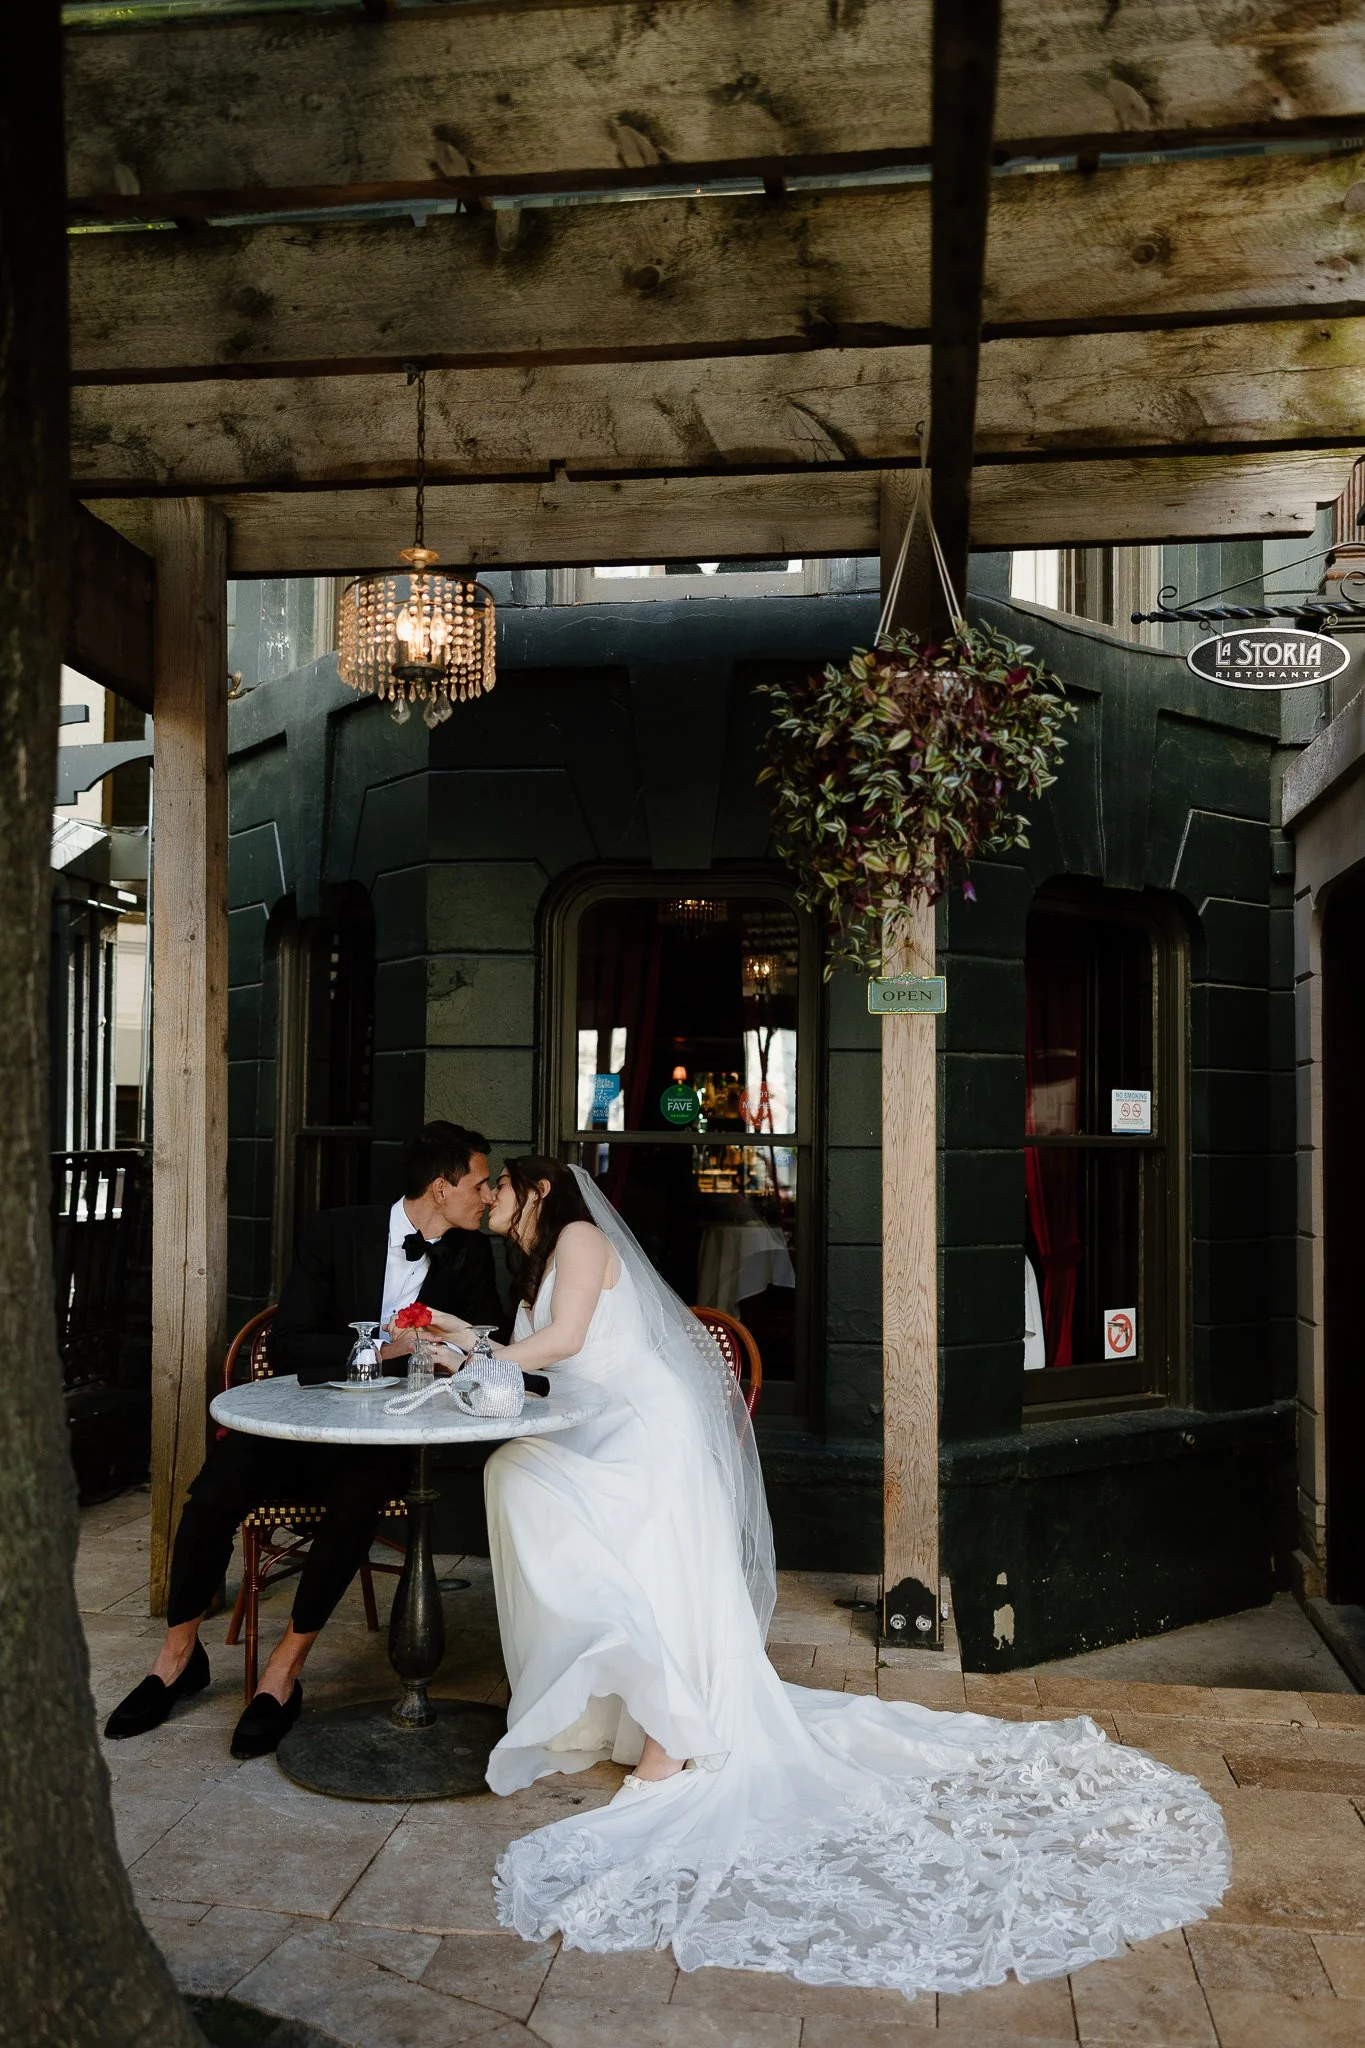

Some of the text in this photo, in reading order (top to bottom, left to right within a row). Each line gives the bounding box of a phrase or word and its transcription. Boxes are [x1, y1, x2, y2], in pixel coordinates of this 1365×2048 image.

[1235, 639, 1322, 666] STORIA
[882, 991, 932, 1001] OPEN
[667, 1102, 693, 1111] FAVE
